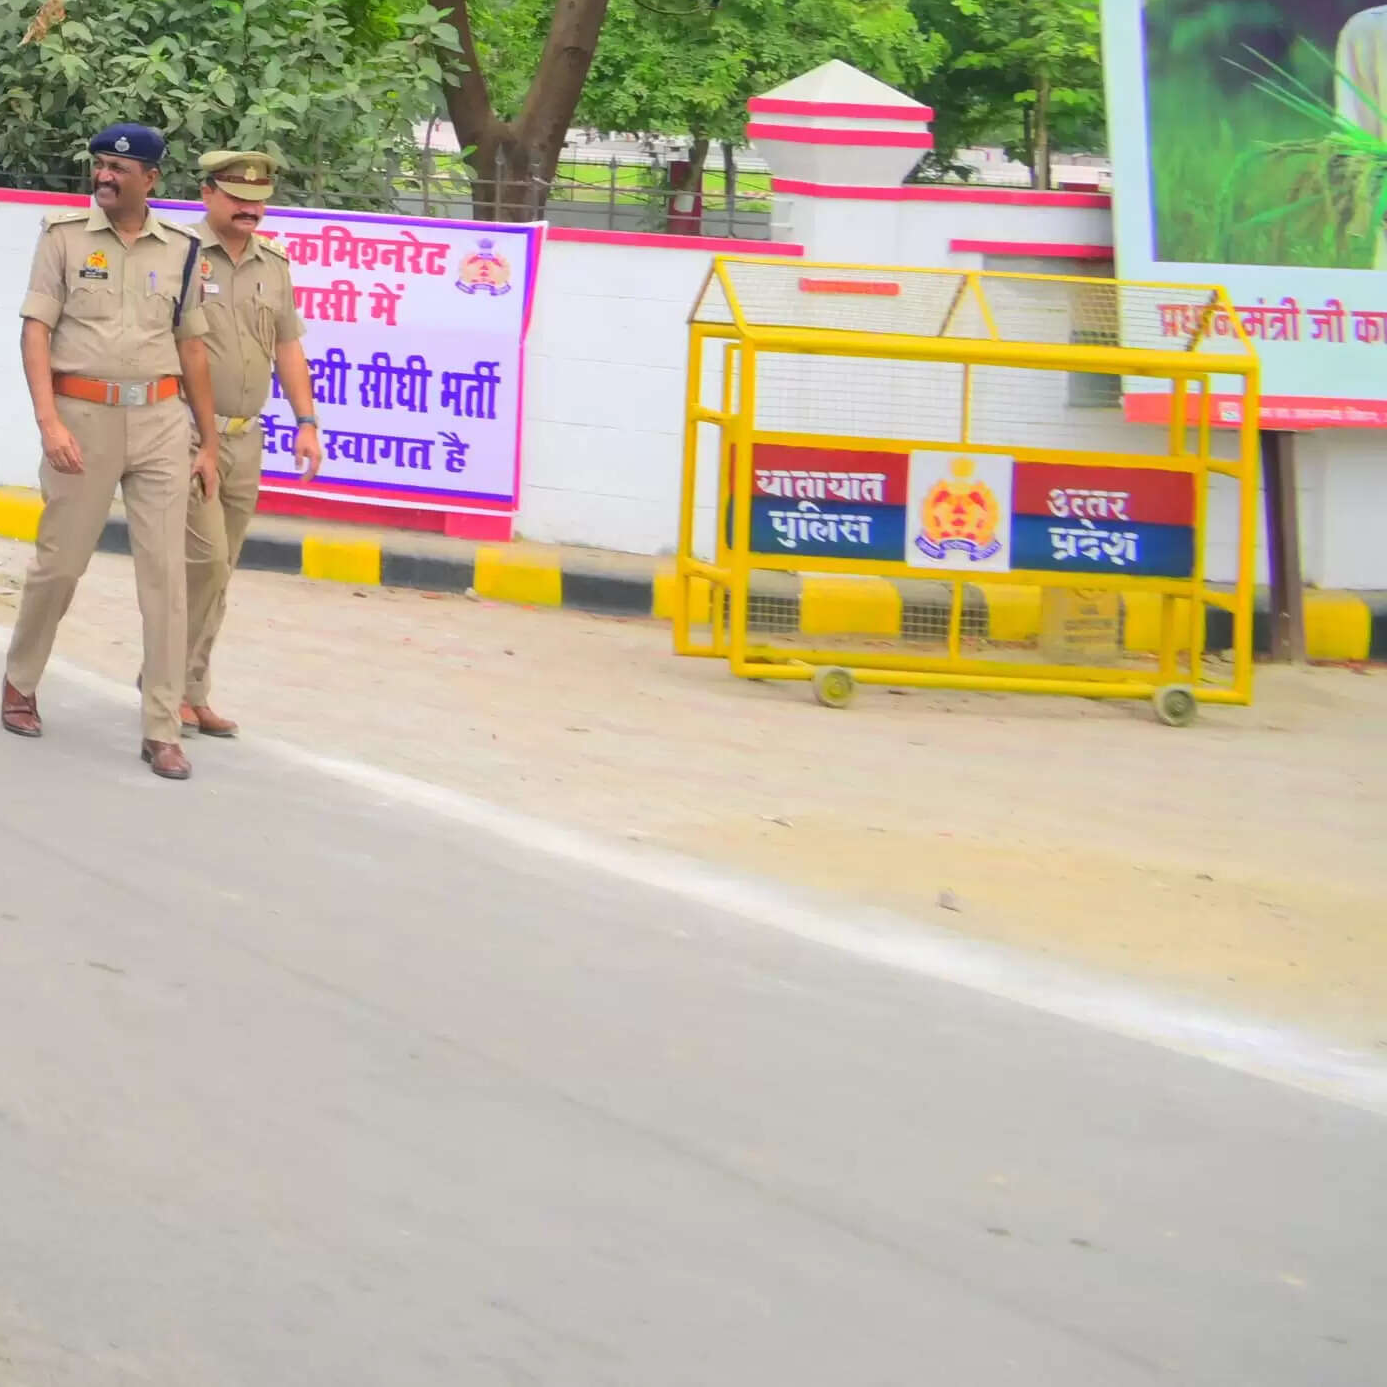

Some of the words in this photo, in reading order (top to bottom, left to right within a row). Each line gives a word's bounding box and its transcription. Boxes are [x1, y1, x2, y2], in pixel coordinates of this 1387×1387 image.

[369, 283, 406, 326] में
[1307, 298, 1345, 343] जी
[441, 361, 501, 420] भर्ती
[323, 429, 435, 470] स्वागत
[437, 431, 470, 473] है
[768, 500, 873, 548] पुलिस
[1048, 517, 1139, 567] प्रदेश
